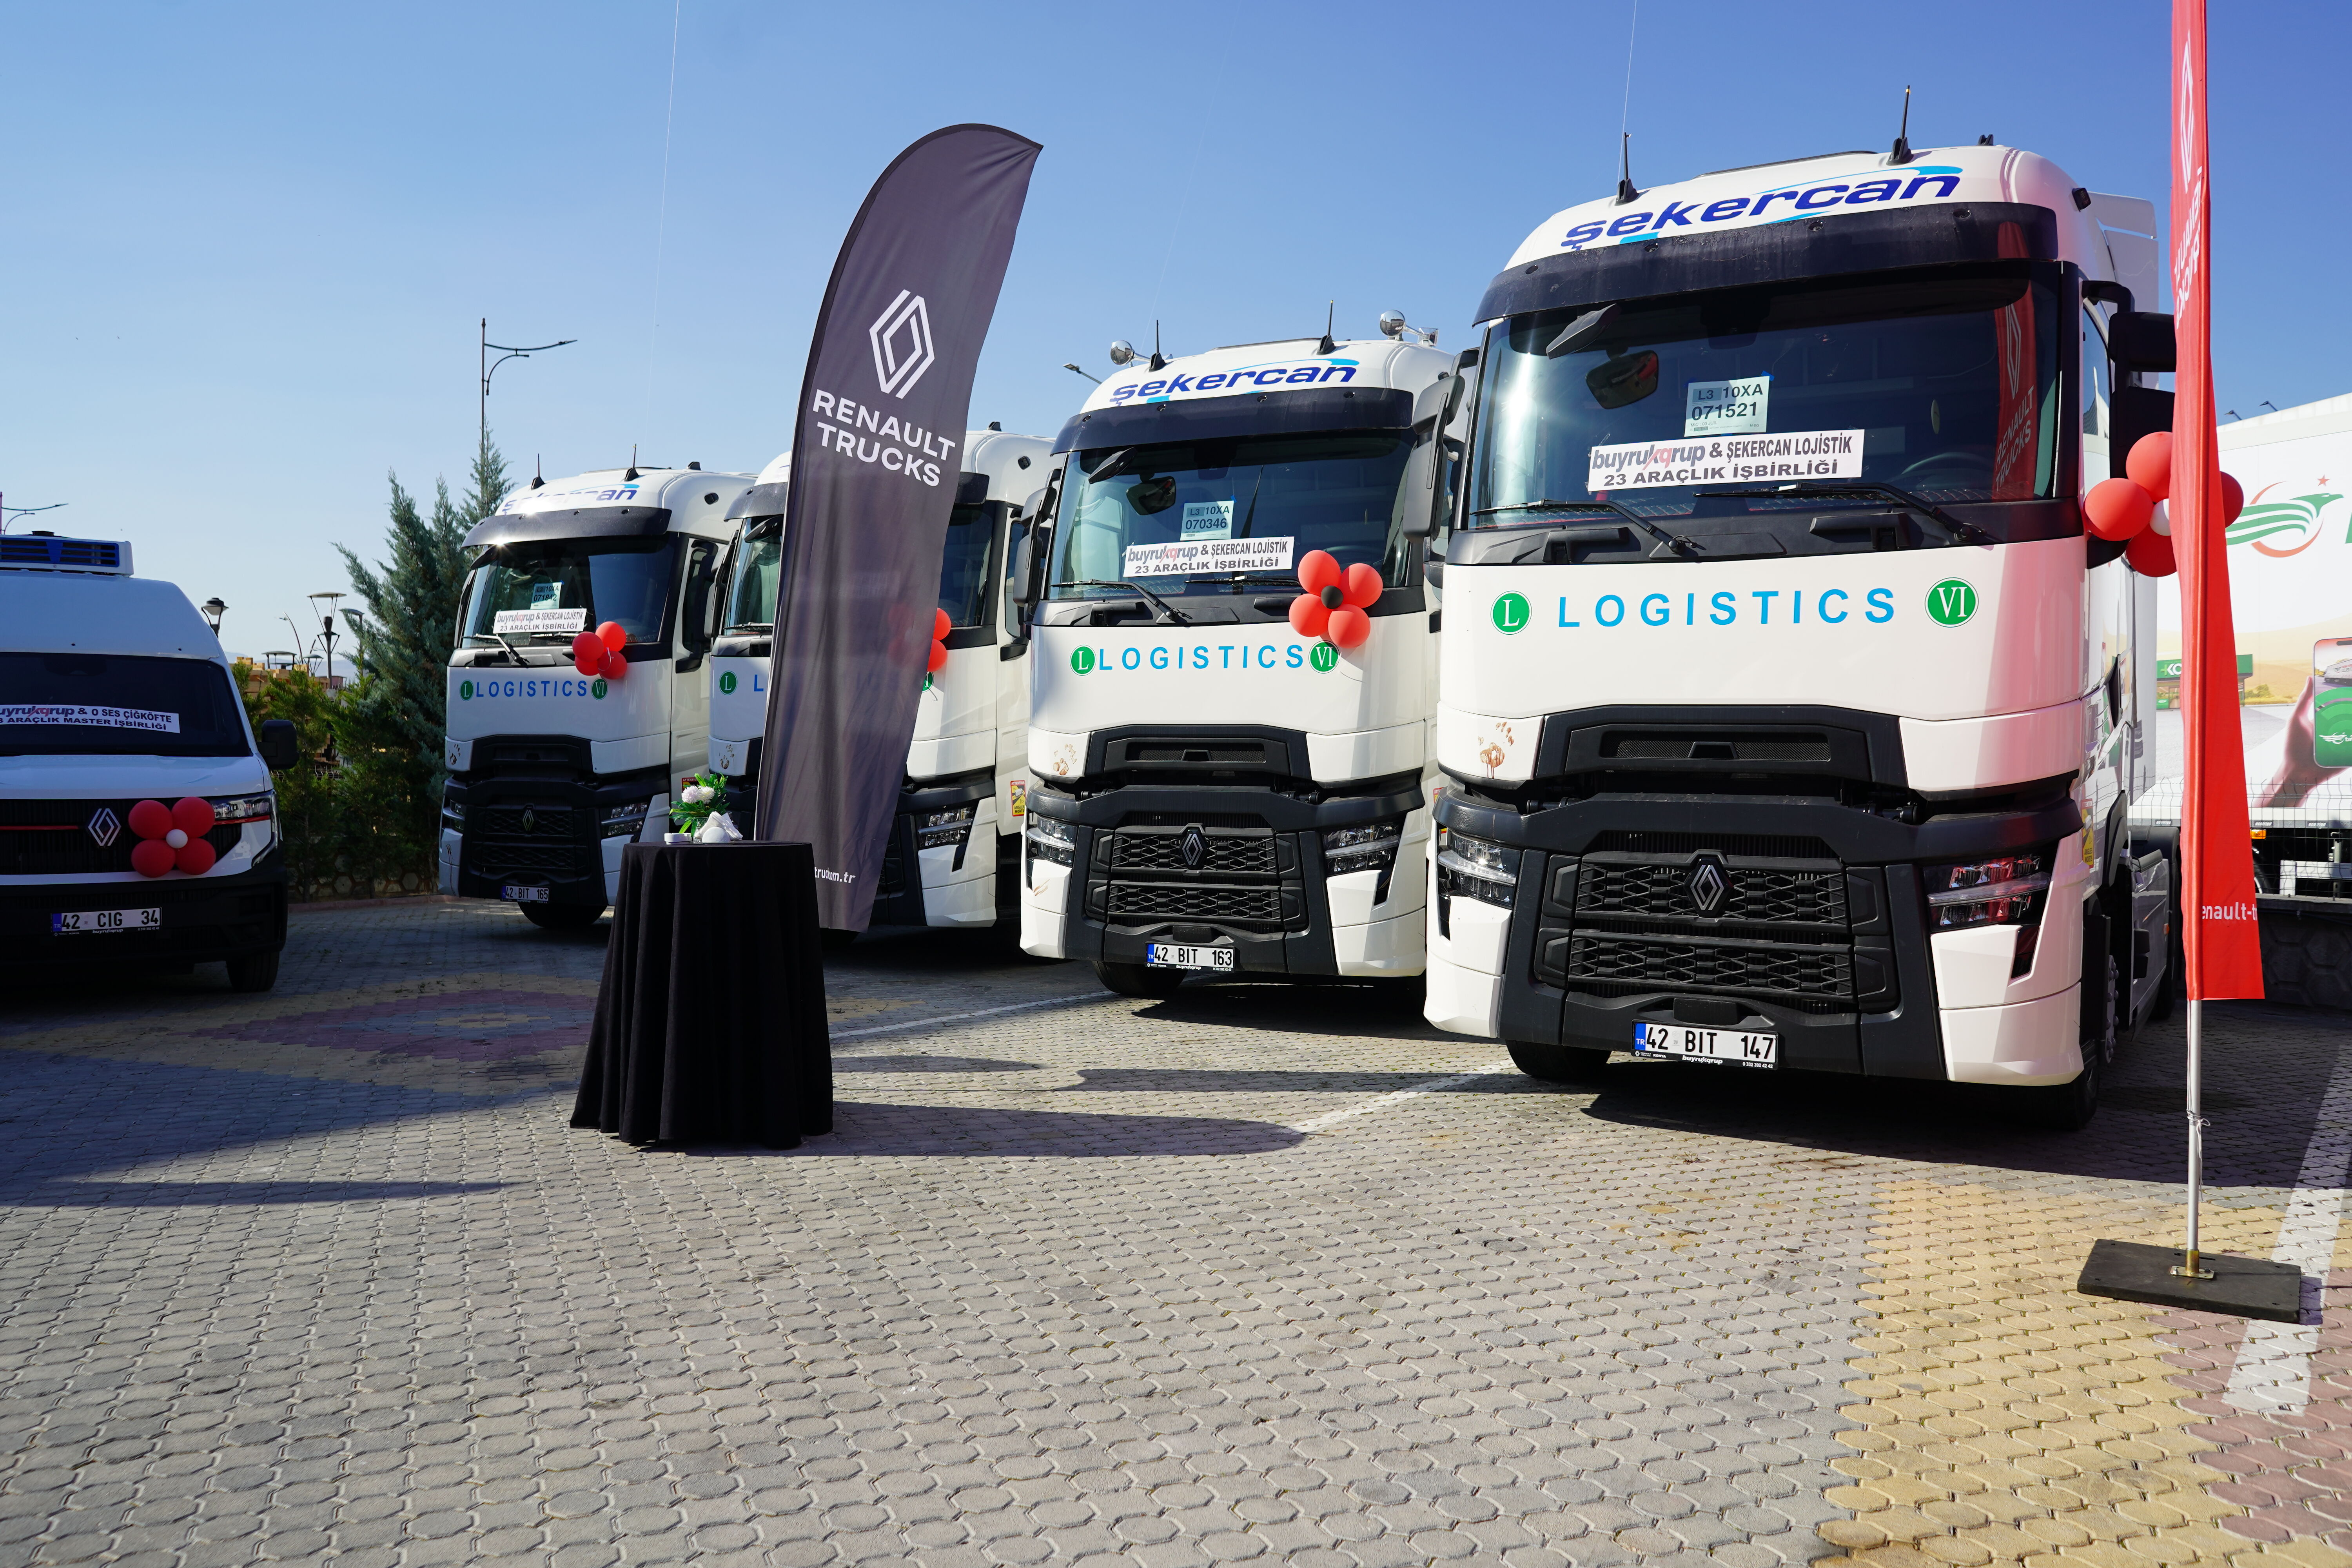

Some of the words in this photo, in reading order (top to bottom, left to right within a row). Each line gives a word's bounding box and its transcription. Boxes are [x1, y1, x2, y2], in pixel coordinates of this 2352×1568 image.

[1560, 174, 1960, 251] şekercan
[1109, 367, 1357, 407] şekercan
[1698, 390, 1713, 400] L3
[1722, 384, 1763, 398] 10XA
[1691, 402, 1756, 421] 071521
[813, 389, 956, 461] RENAULT
[817, 421, 940, 486] TRUCKS
[1710, 442, 1723, 457] &
[1727, 439, 1791, 463] ŞEKERCAN
[1795, 432, 1852, 455] LOJİSTİK
[1604, 474, 1626, 486] 23
[1633, 467, 1726, 484] ARAÇLIK
[1733, 459, 1837, 480] İŞBİRLİĞİ
[1205, 506, 1229, 515] 10XA
[1185, 518, 1227, 530] 070346
[1200, 544, 1209, 555] &
[1211, 542, 1251, 559] ŞEKERCAN
[1253, 538, 1287, 554] LOJİSTİK
[1134, 566, 1149, 574] 23
[1153, 561, 1210, 572] ARAÇLIK
[1215, 557, 1278, 571] İŞBİRLİĞİ
[541, 612, 563, 622] ŞEKERCAN
[564, 610, 583, 620] LOJİSTİK
[1502, 599, 1520, 626] L
[1558, 588, 1895, 627] LOGISTICS
[1935, 586, 1967, 618] VI
[543, 622, 577, 631] İŞBİRLİĞİ
[1077, 651, 1089, 671] L
[1099, 644, 1303, 670] LOGISTICS
[1316, 647, 1333, 667] VI
[464, 684, 470, 697] L
[476, 681, 587, 697] LOGISTICS
[595, 682, 604, 696] VI
[724, 675, 733, 691] L
[102, 709, 120, 717] SES
[123, 710, 172, 723] ÇİĞKÖFTE
[114, 719, 166, 730] İŞBİRLİĞİ
[506, 887, 513, 898] 42
[518, 887, 530, 899] BIT
[537, 889, 548, 900] 165
[62, 915, 80, 929] 42
[98, 912, 122, 927] CIG
[141, 910, 159, 924] 34
[1154, 946, 1168, 962] 42
[1178, 948, 1198, 964] BIT
[1212, 950, 1232, 965] 163
[1646, 1027, 1668, 1050] 42
[1685, 1029, 1717, 1054] BIT
[1740, 1035, 1773, 1059] 147
